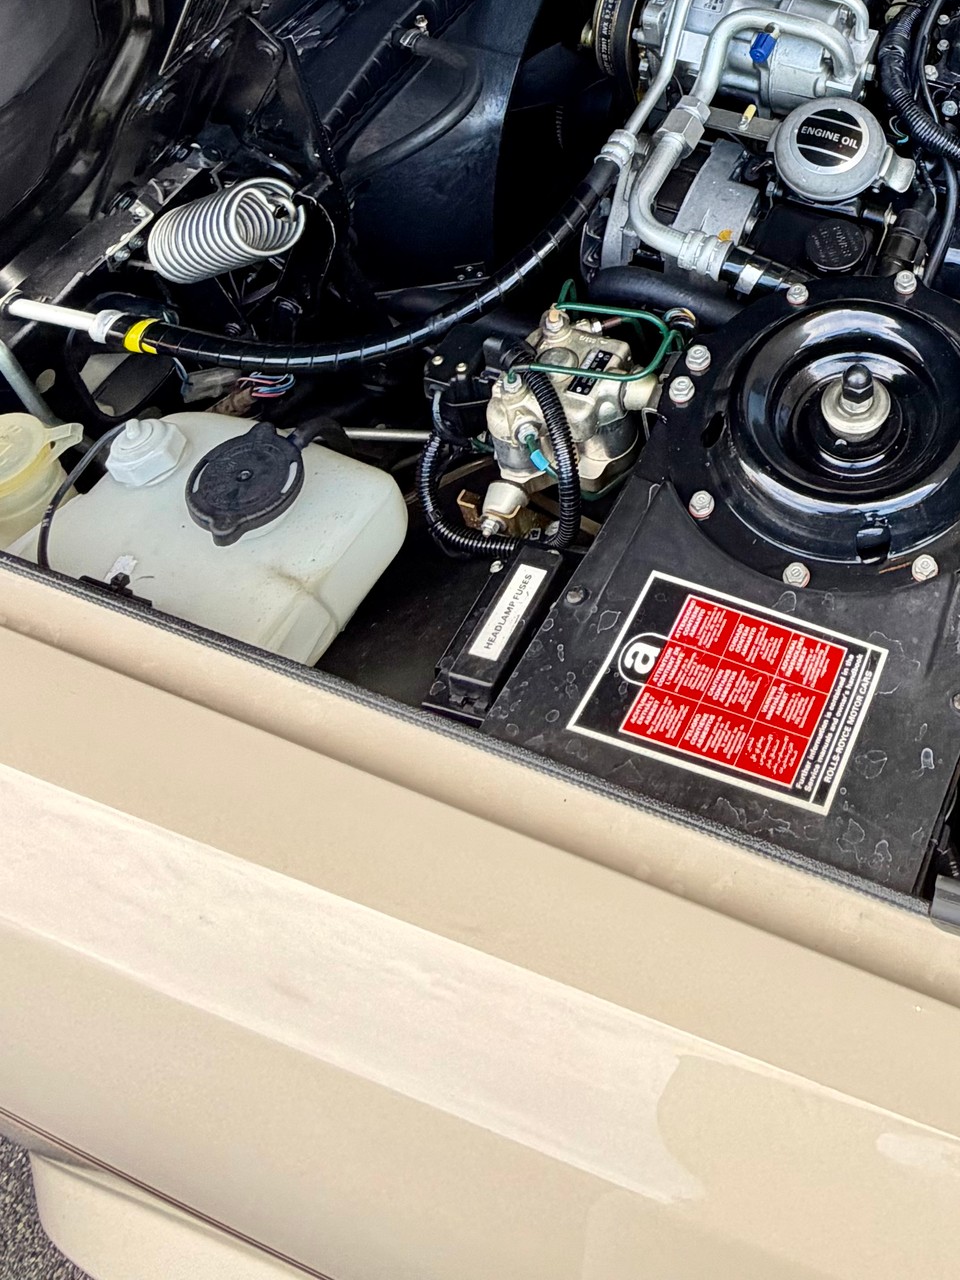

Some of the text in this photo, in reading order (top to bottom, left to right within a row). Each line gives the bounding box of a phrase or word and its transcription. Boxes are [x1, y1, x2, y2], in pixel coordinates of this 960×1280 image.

[800, 126, 858, 149] ENGINE OIL
[484, 574, 532, 650] HEADLAMP FUSES
[681, 605, 701, 636] CONTIENE
[687, 608, 706, 637] AMIANTO
[727, 622, 745, 651] CUIDADO
[739, 626, 757, 656] AMIANTO
[624, 641, 661, 674] a
[651, 646, 674, 682] ATTENTION
[656, 655, 676, 687] CONTIENT
[793, 646, 808, 671] ASBEST
[706, 668, 724, 696] CAUTION
[711, 668, 731, 700] CONTAINS
[718, 670, 738, 703] ASBESTOS
[628, 691, 650, 724] ACHTUNG
[643, 699, 661, 725] ASBEST
[774, 691, 789, 715] ASBEST
[683, 712, 701, 740] PELIGRO
[689, 712, 709, 745] CONTIENE
[695, 713, 716, 748] ASBESTOS
[795, 653, 854, 789] Further information is contained in the
[803, 653, 863, 792] Service manuals and owner's handbook
[823, 669, 873, 783] ROLLS-ROYCE MOTOR CARS
